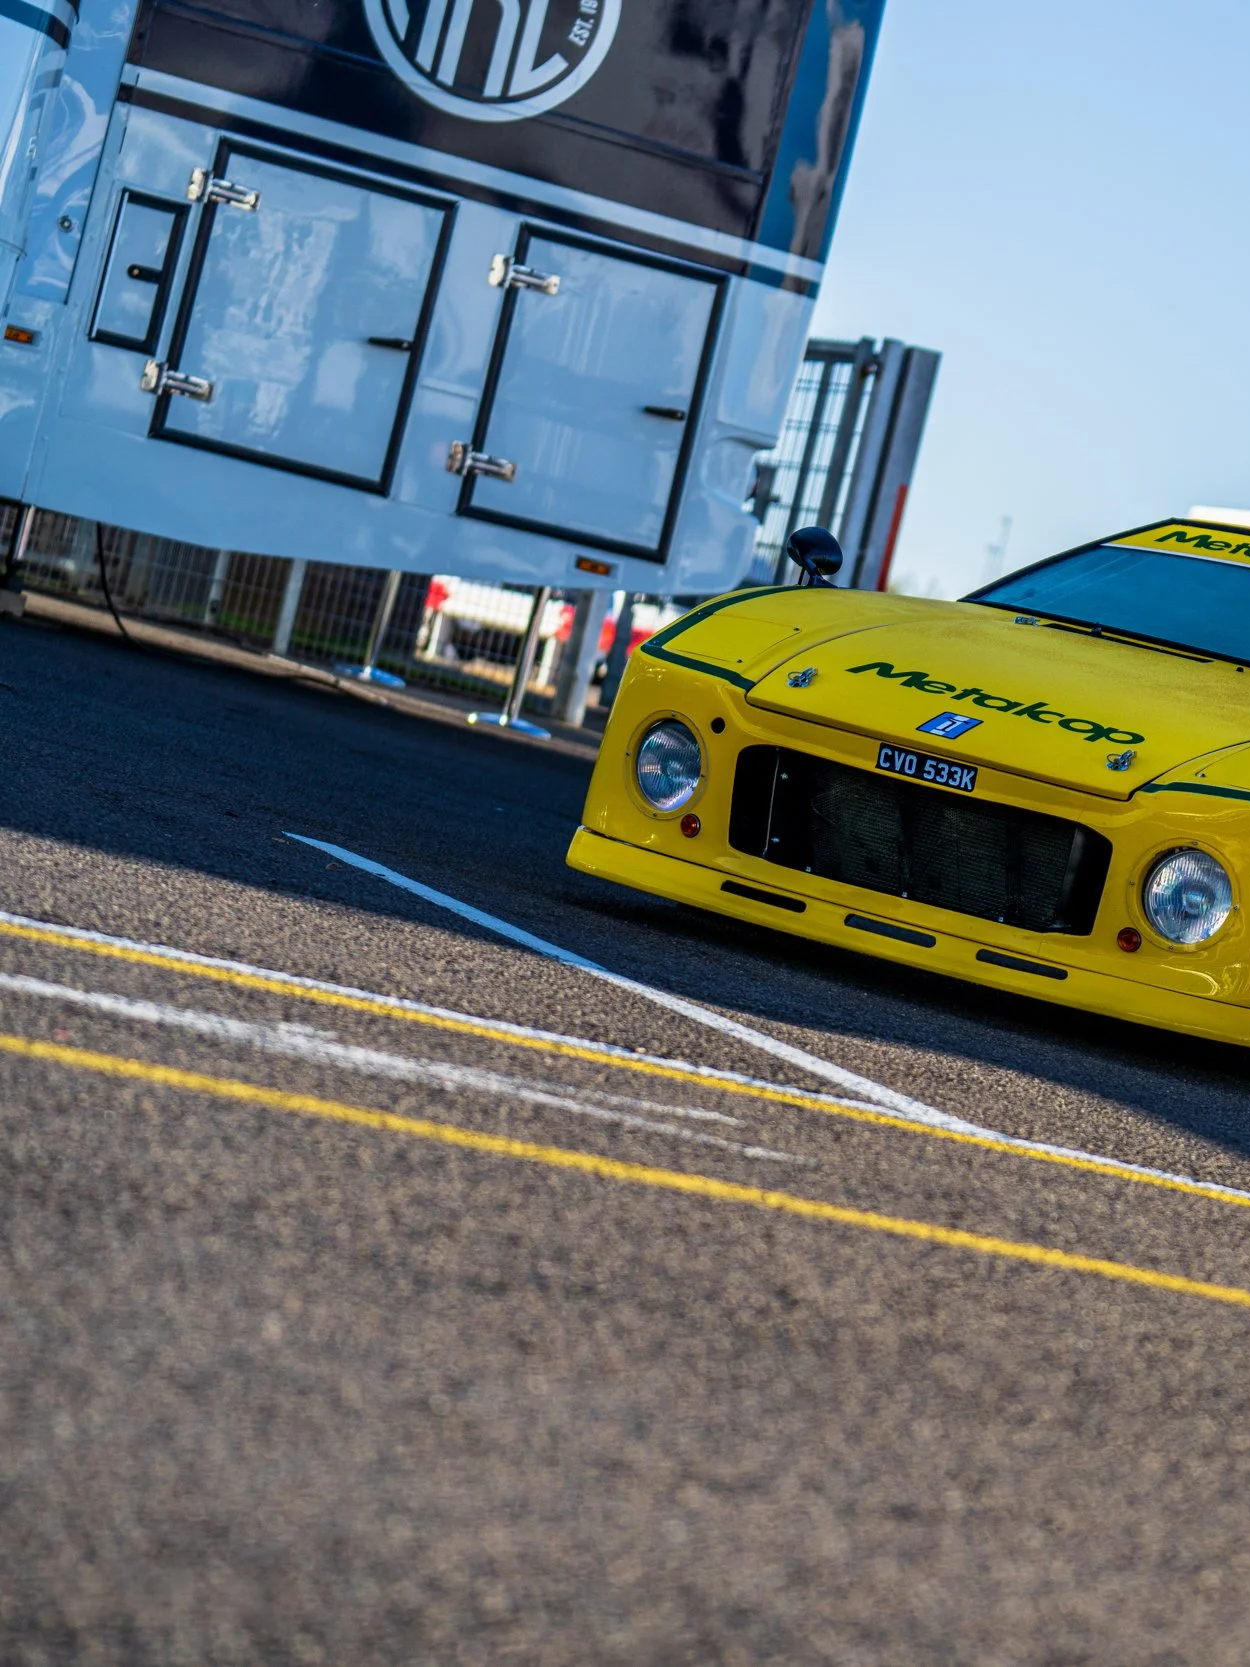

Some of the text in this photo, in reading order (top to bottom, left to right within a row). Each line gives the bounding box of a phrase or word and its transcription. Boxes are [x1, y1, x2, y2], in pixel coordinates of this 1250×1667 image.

[845, 661, 1145, 745] Metalcop
[880, 747, 975, 790] CVO 533K
